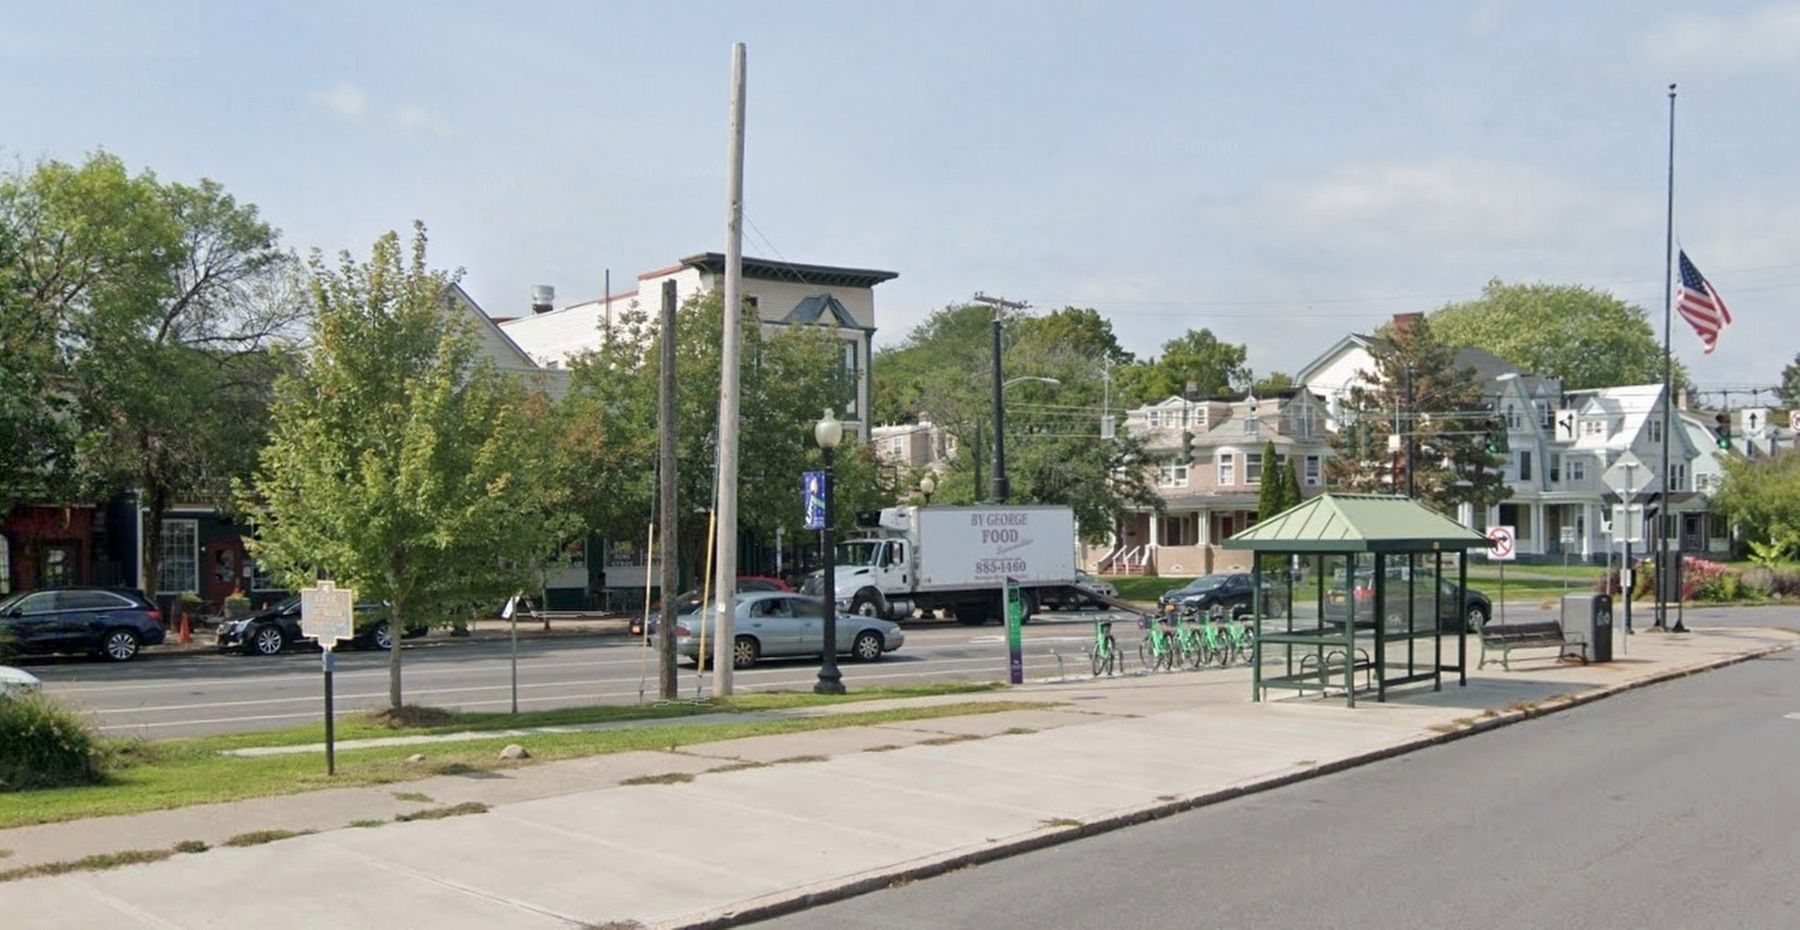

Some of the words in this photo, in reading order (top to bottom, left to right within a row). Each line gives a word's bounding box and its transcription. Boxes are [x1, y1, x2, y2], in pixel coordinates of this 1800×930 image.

[971, 513, 984, 526] BY
[986, 513, 1029, 526] GEORGE
[982, 529, 1019, 544] FOOD
[975, 560, 1027, 574] 885-1460
